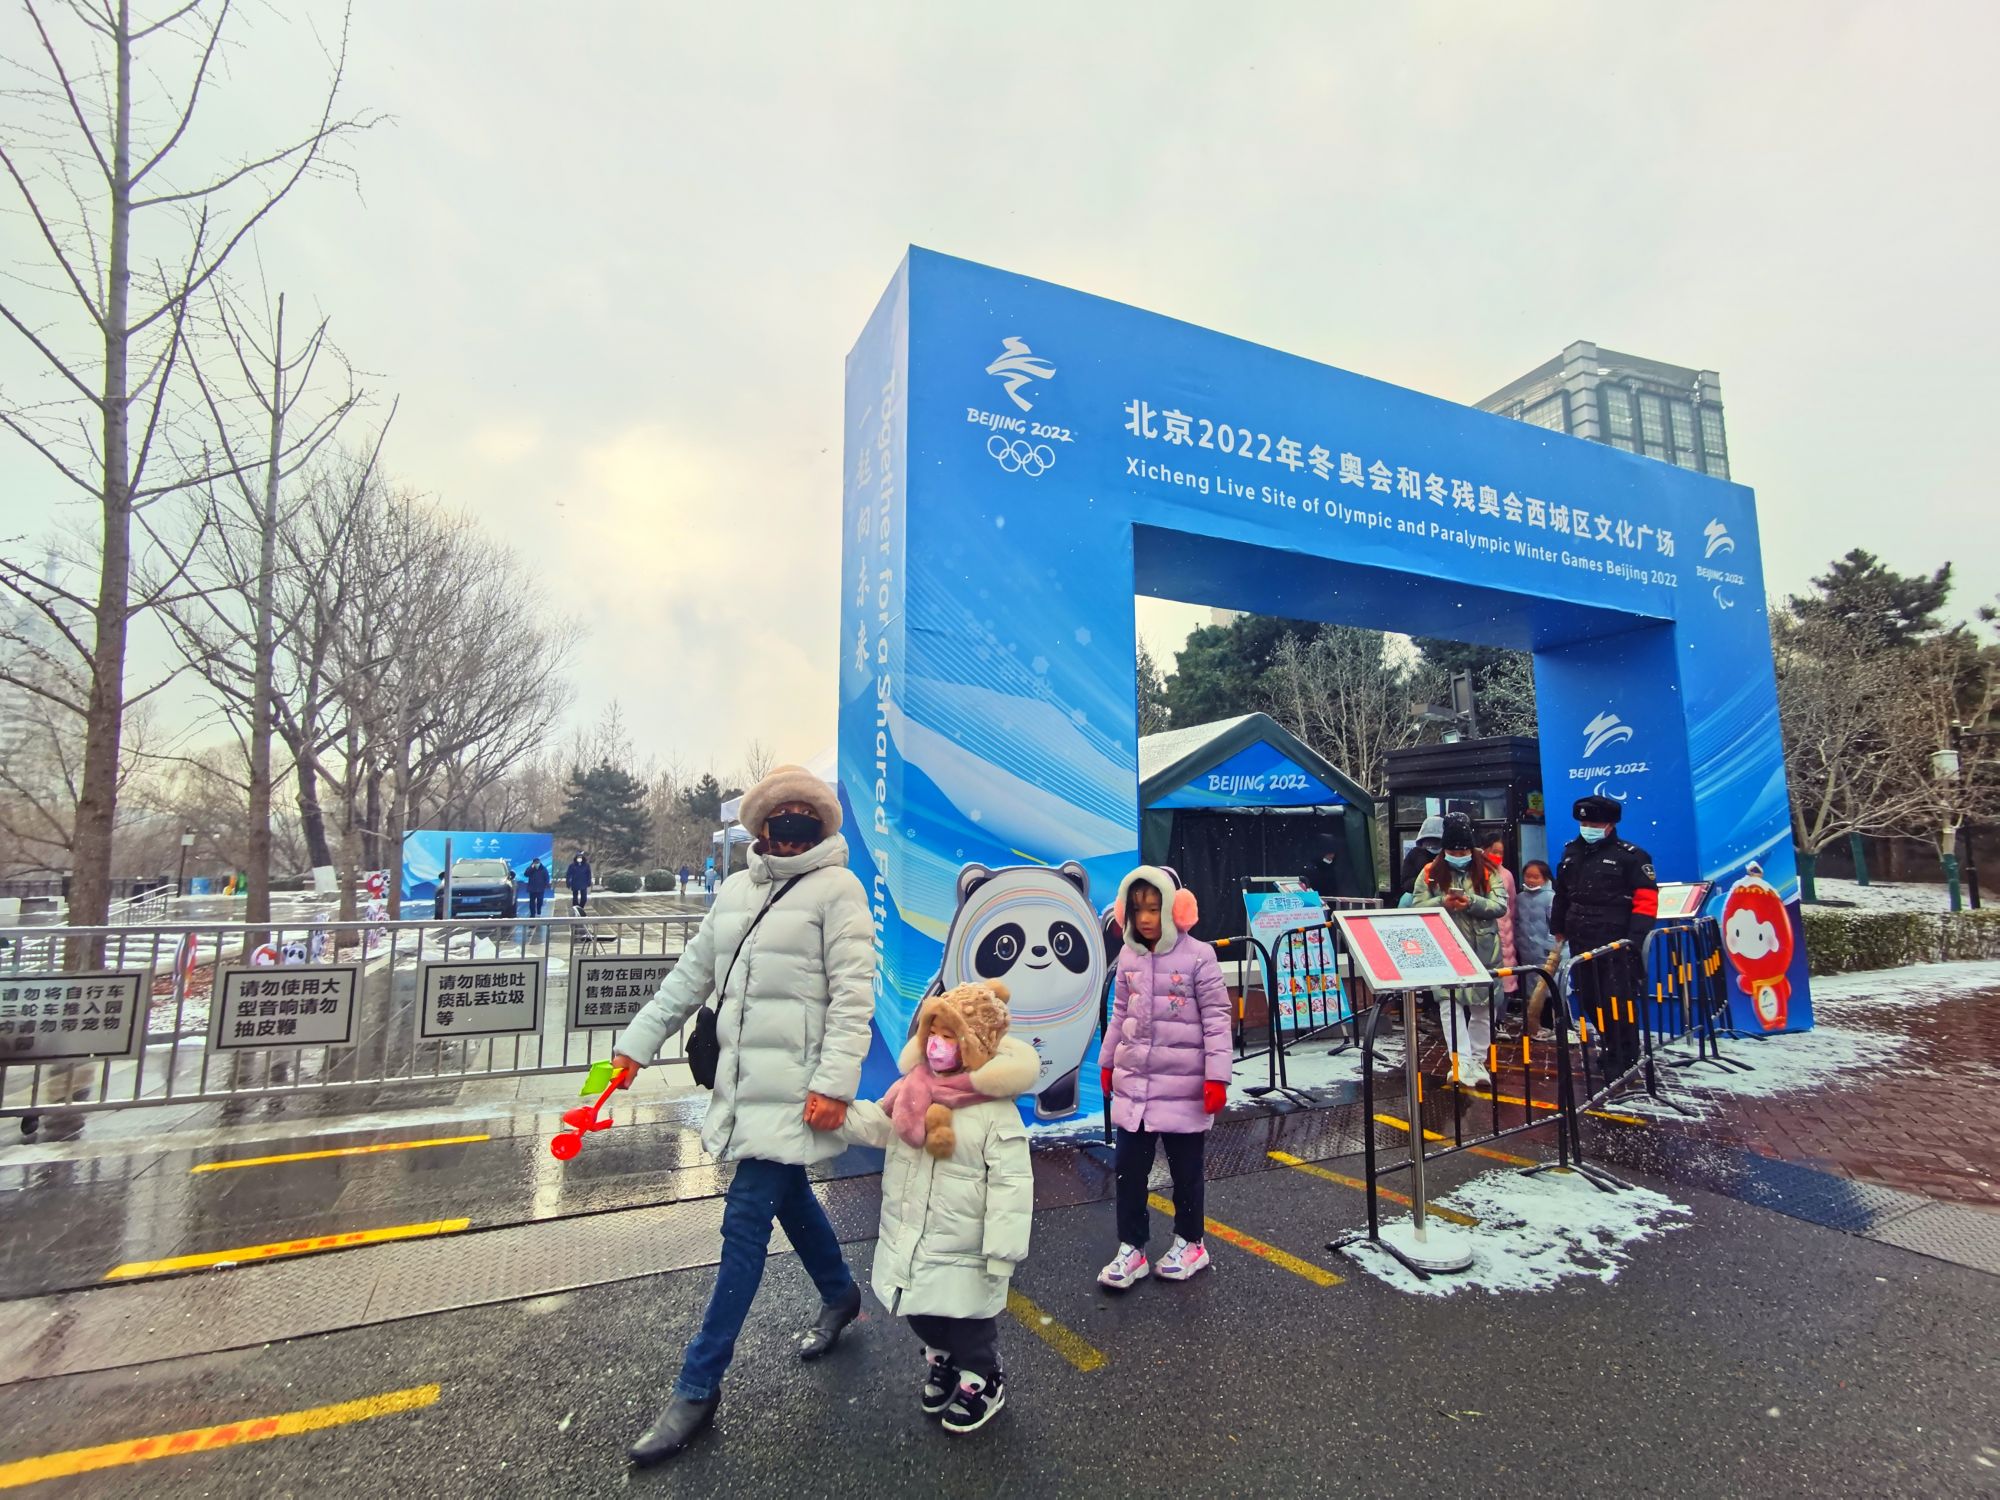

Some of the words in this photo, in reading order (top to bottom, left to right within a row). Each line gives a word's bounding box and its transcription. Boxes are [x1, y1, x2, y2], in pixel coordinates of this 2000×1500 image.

[966, 407, 1027, 434] BEIJING
[1030, 422, 1075, 443] 2022
[878, 371, 896, 555] Together
[1124, 399, 1676, 557] 北京2022年冬奥会和冬残奥会西城区文化广场
[1126, 456, 1210, 495] Xicheng
[1216, 476, 1256, 500] Live
[1261, 486, 1297, 509] Site
[1302, 497, 1319, 514] of
[1324, 500, 1393, 530] Olympic
[1397, 517, 1426, 537] and
[1430, 524, 1511, 554] Paralympic
[1514, 540, 1558, 563] Winter
[1561, 550, 1603, 573] Games
[1606, 560, 1648, 585] Beijing
[1651, 569, 1678, 588] 2022
[1696, 565, 1724, 582] BEIJING
[1724, 572, 1745, 585] 2022
[878, 567, 892, 627] for
[877, 638, 888, 664] a
[875, 674, 892, 835] Shared
[1569, 765, 1611, 781] BEIJING
[1614, 762, 1651, 775] 2022
[1208, 774, 1265, 796] BEIJING
[1269, 774, 1311, 791] 2022
[873, 848, 889, 997] Future
[240, 977, 341, 997] 请勿使用大
[438, 972, 526, 990] 请勿随地吐
[3, 985, 125, 1001] 请勿将自行车
[437, 990, 525, 1009] 痰乱丢垃圾
[586, 984, 661, 999] 售物品及从
[0, 1000, 123, 1018] 三轮车推入园
[237, 998, 338, 1017] 型音响请勿
[584, 1001, 641, 1016] 经营活动
[234, 1018, 298, 1039] 抽皮鞭
[436, 1010, 455, 1027] 等
